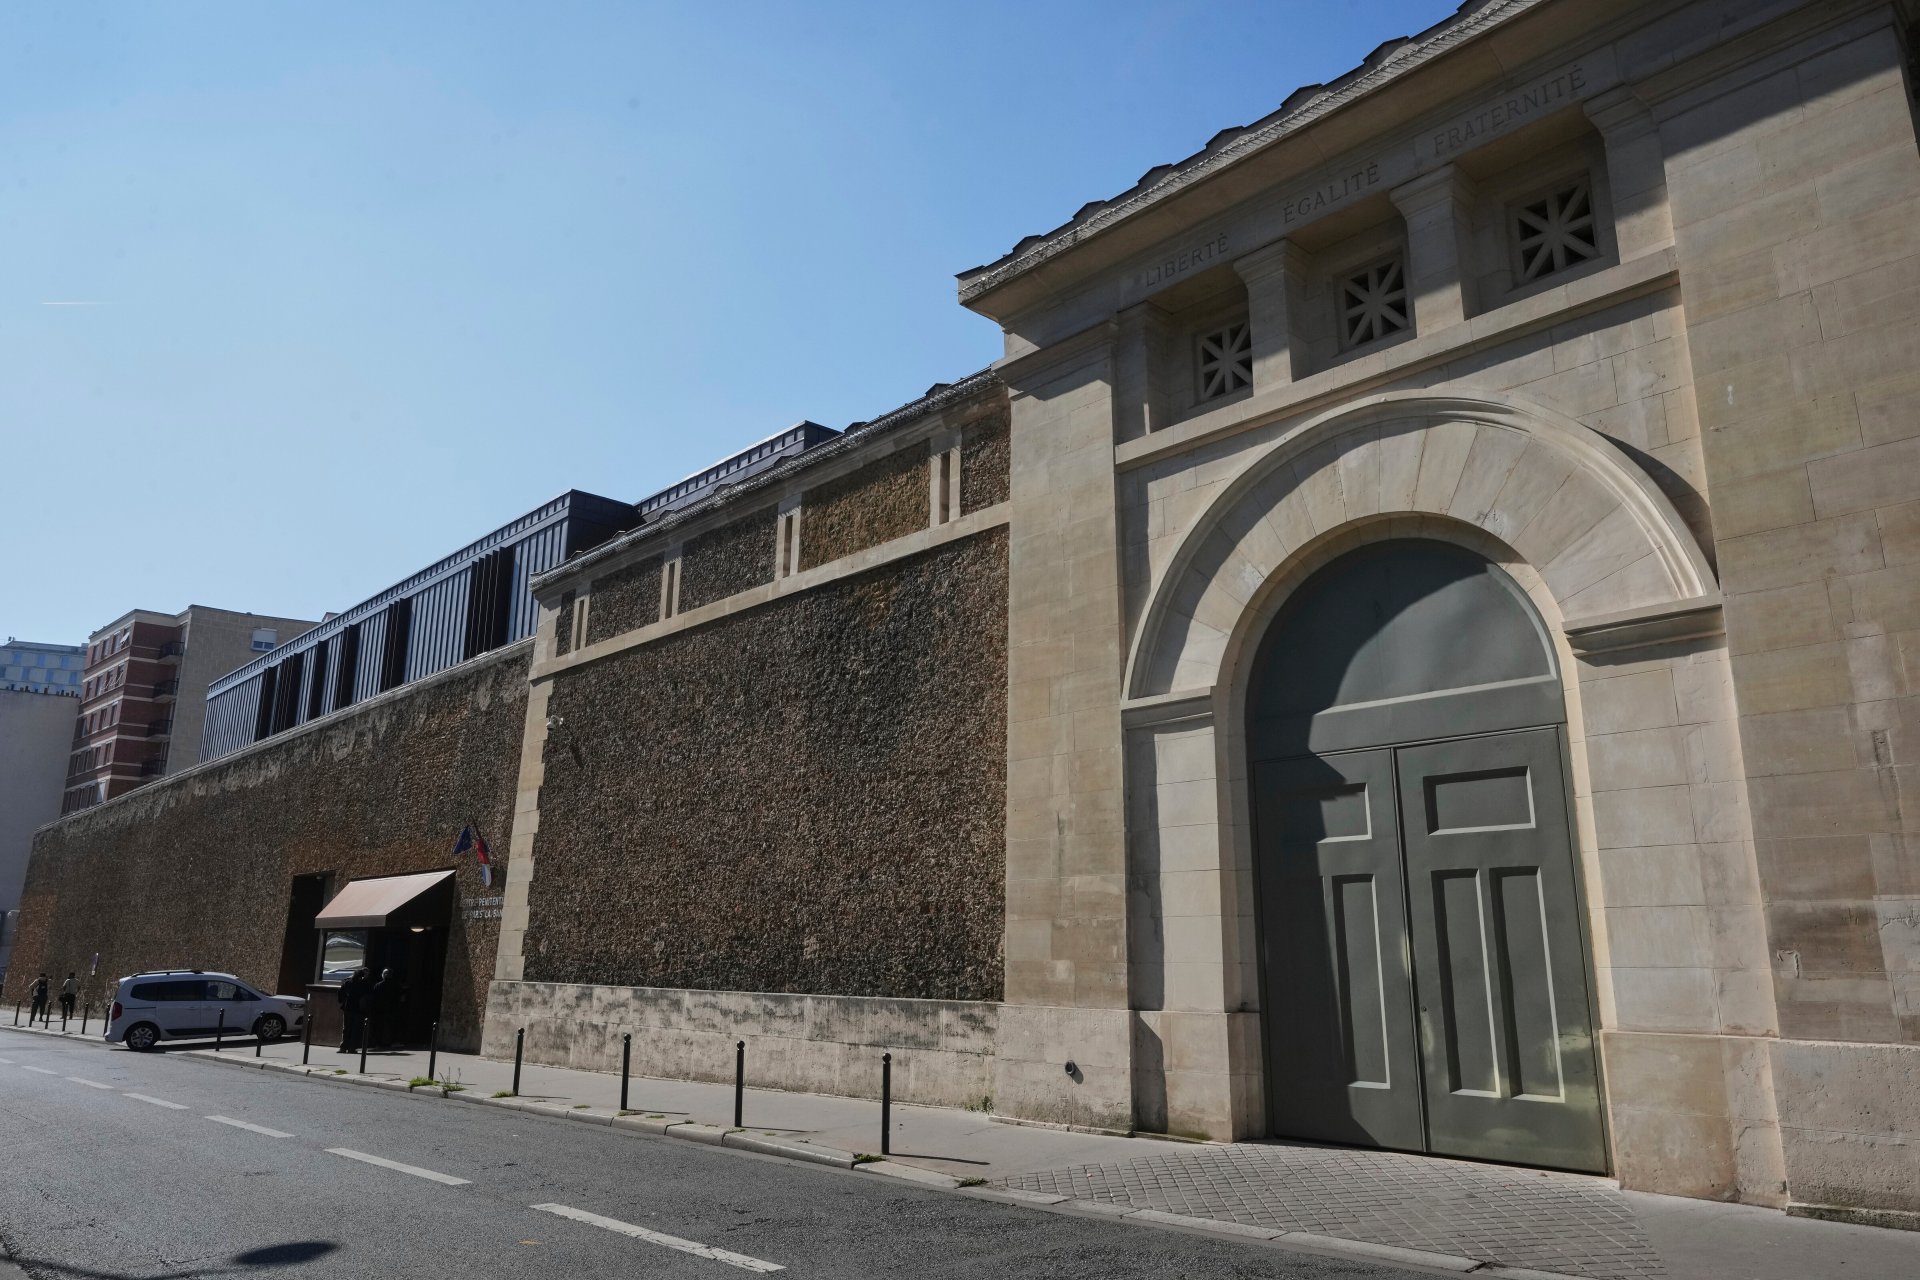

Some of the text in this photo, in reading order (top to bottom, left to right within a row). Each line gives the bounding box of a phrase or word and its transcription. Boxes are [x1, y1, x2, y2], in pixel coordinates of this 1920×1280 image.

[1146, 64, 1587, 287] LIBERTÉ ÉGALITÉ FRATERNITÉ
